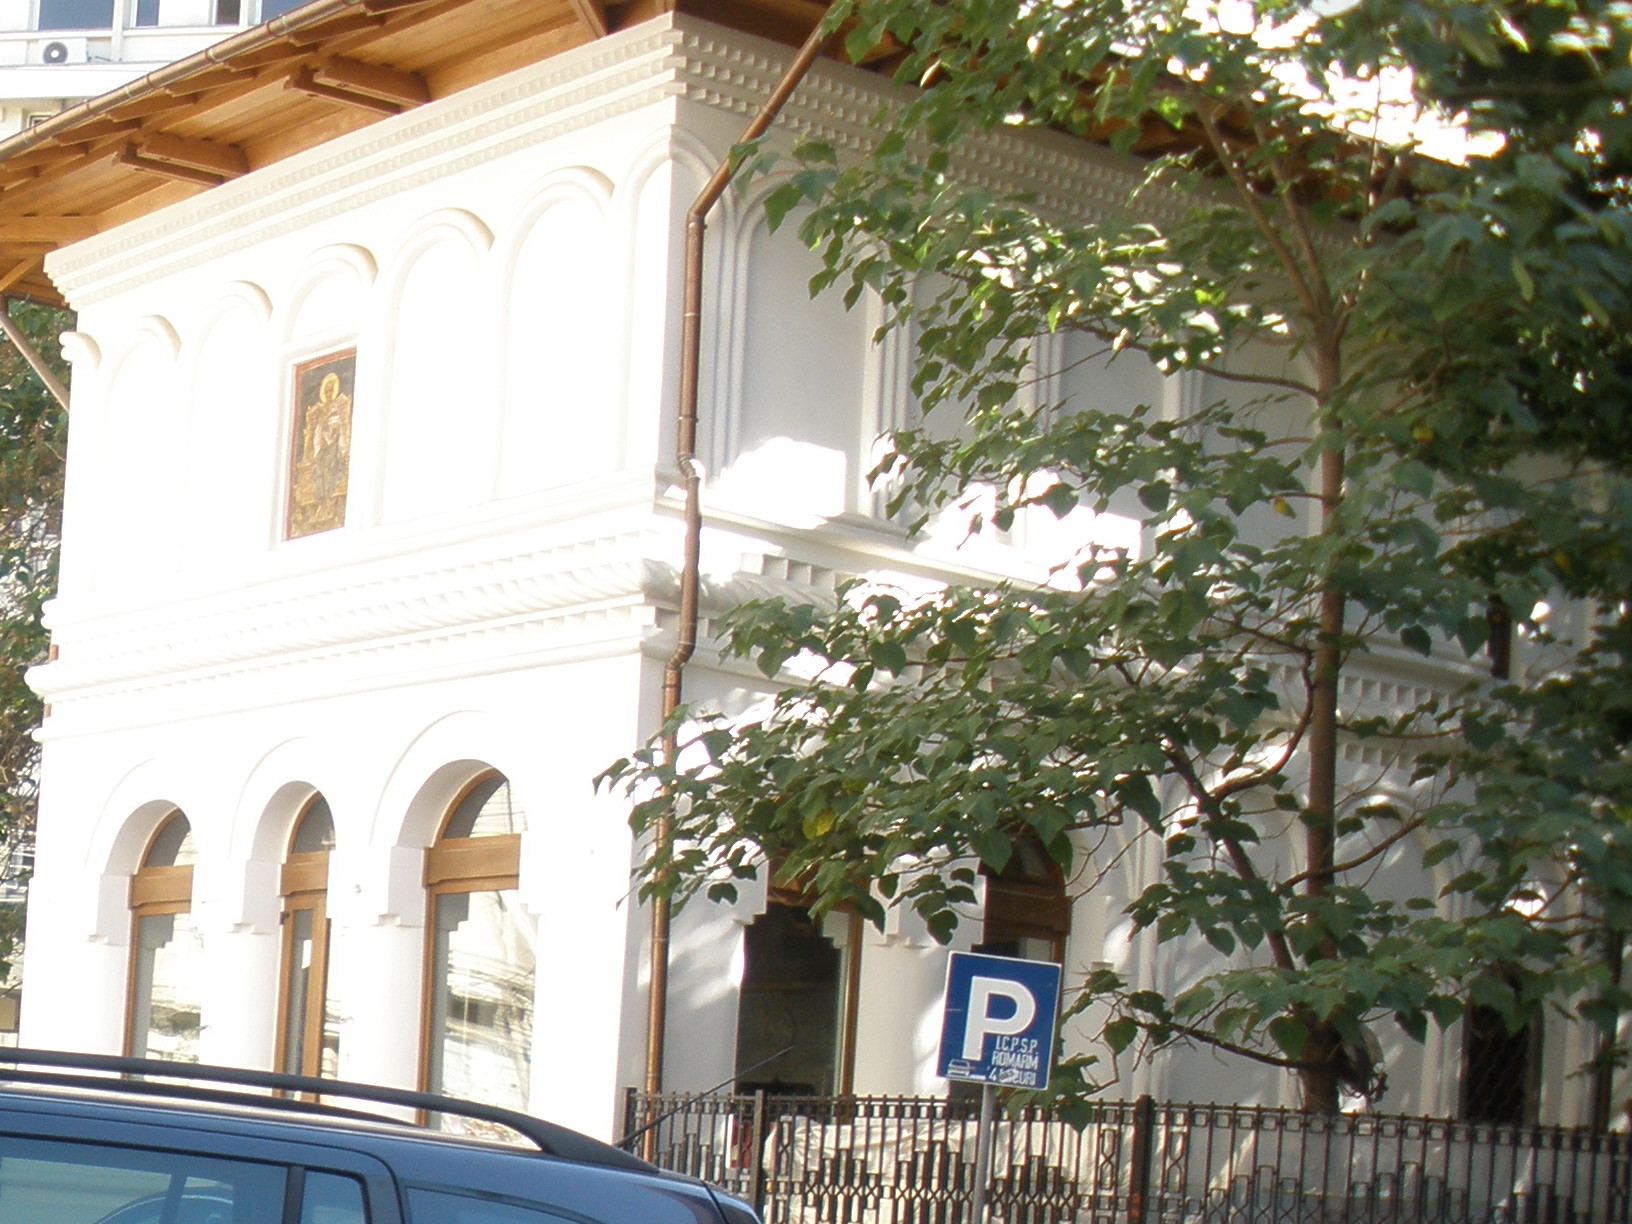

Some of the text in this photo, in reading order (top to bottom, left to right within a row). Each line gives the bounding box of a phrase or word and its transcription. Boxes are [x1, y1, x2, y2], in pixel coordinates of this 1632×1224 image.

[961, 975, 1037, 1062] P
[990, 1050, 1039, 1070] ROMARM
[988, 1067, 997, 1081] 4
